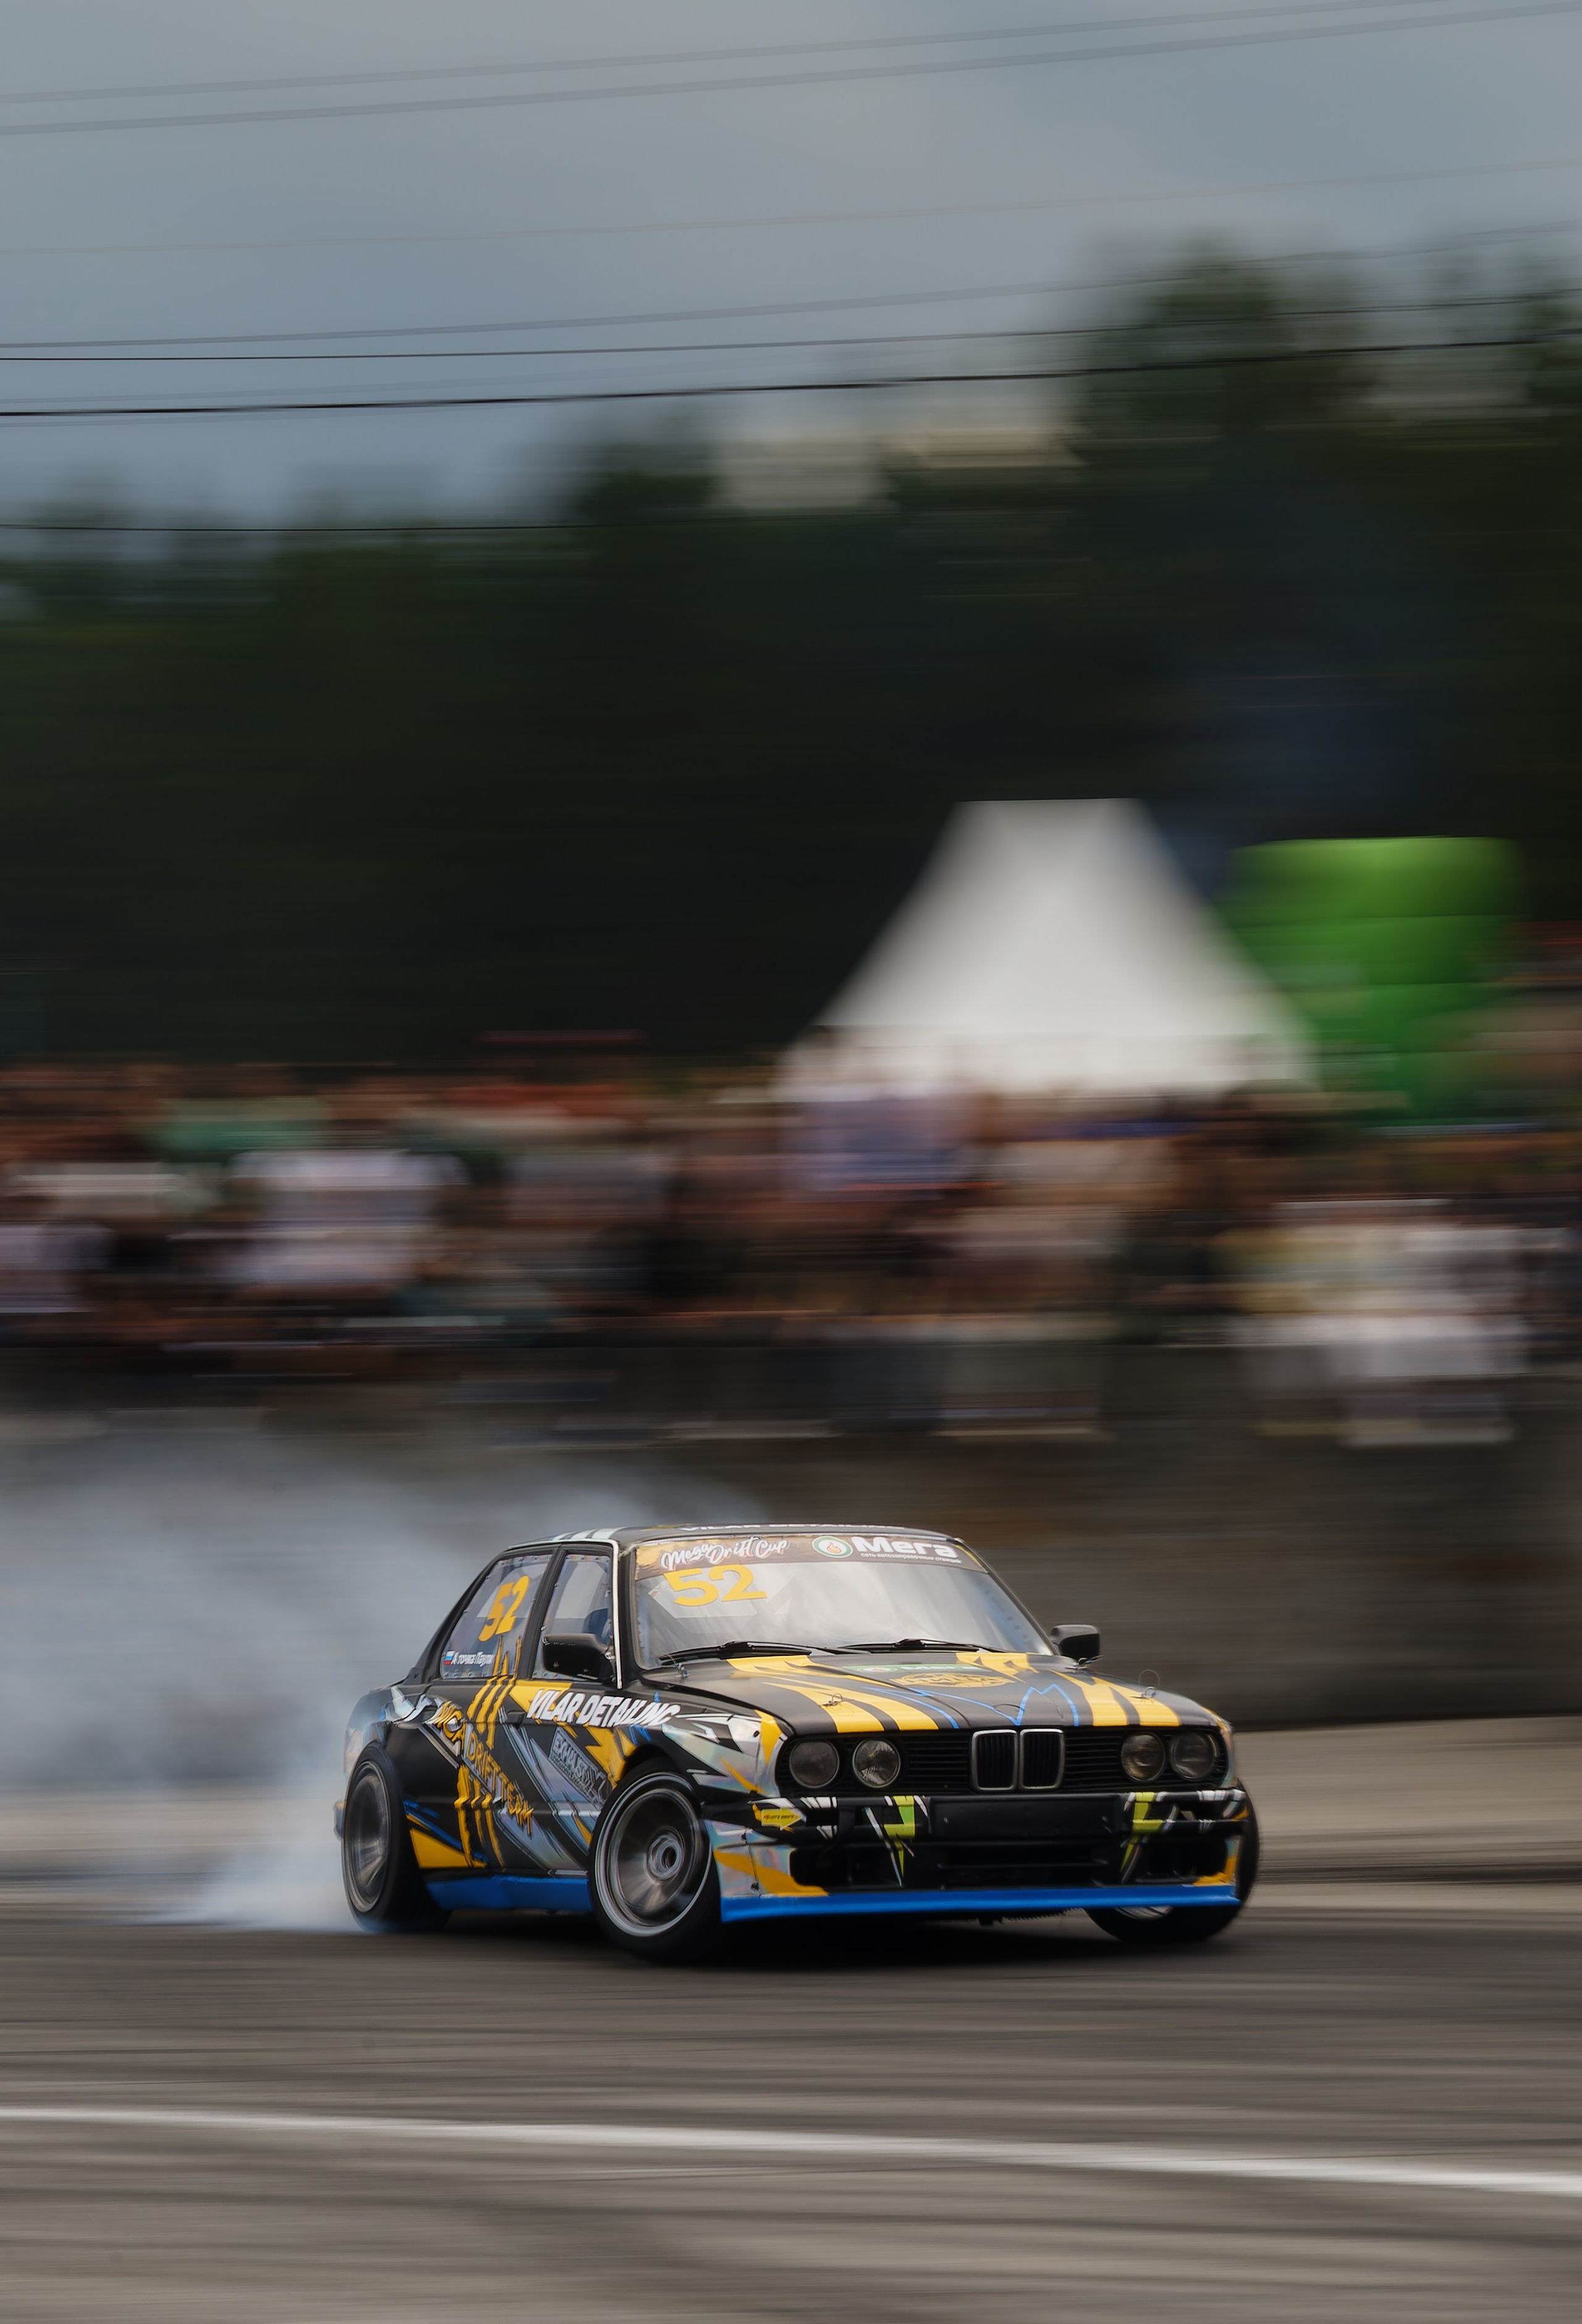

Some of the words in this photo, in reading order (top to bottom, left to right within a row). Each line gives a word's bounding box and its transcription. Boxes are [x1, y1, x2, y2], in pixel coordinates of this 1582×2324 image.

[661, 1544, 713, 1571] Mega
[706, 1536, 760, 1564] Drift
[755, 1540, 789, 1558] Cup
[851, 1536, 958, 1558] Мега
[663, 1564, 767, 1606] 52
[478, 1575, 530, 1642] 52
[526, 1689, 586, 1723] VILAR
[575, 1695, 681, 1728] DETAILING
[466, 1731, 501, 1792] DRIFT
[499, 1770, 535, 1838] TEAM
